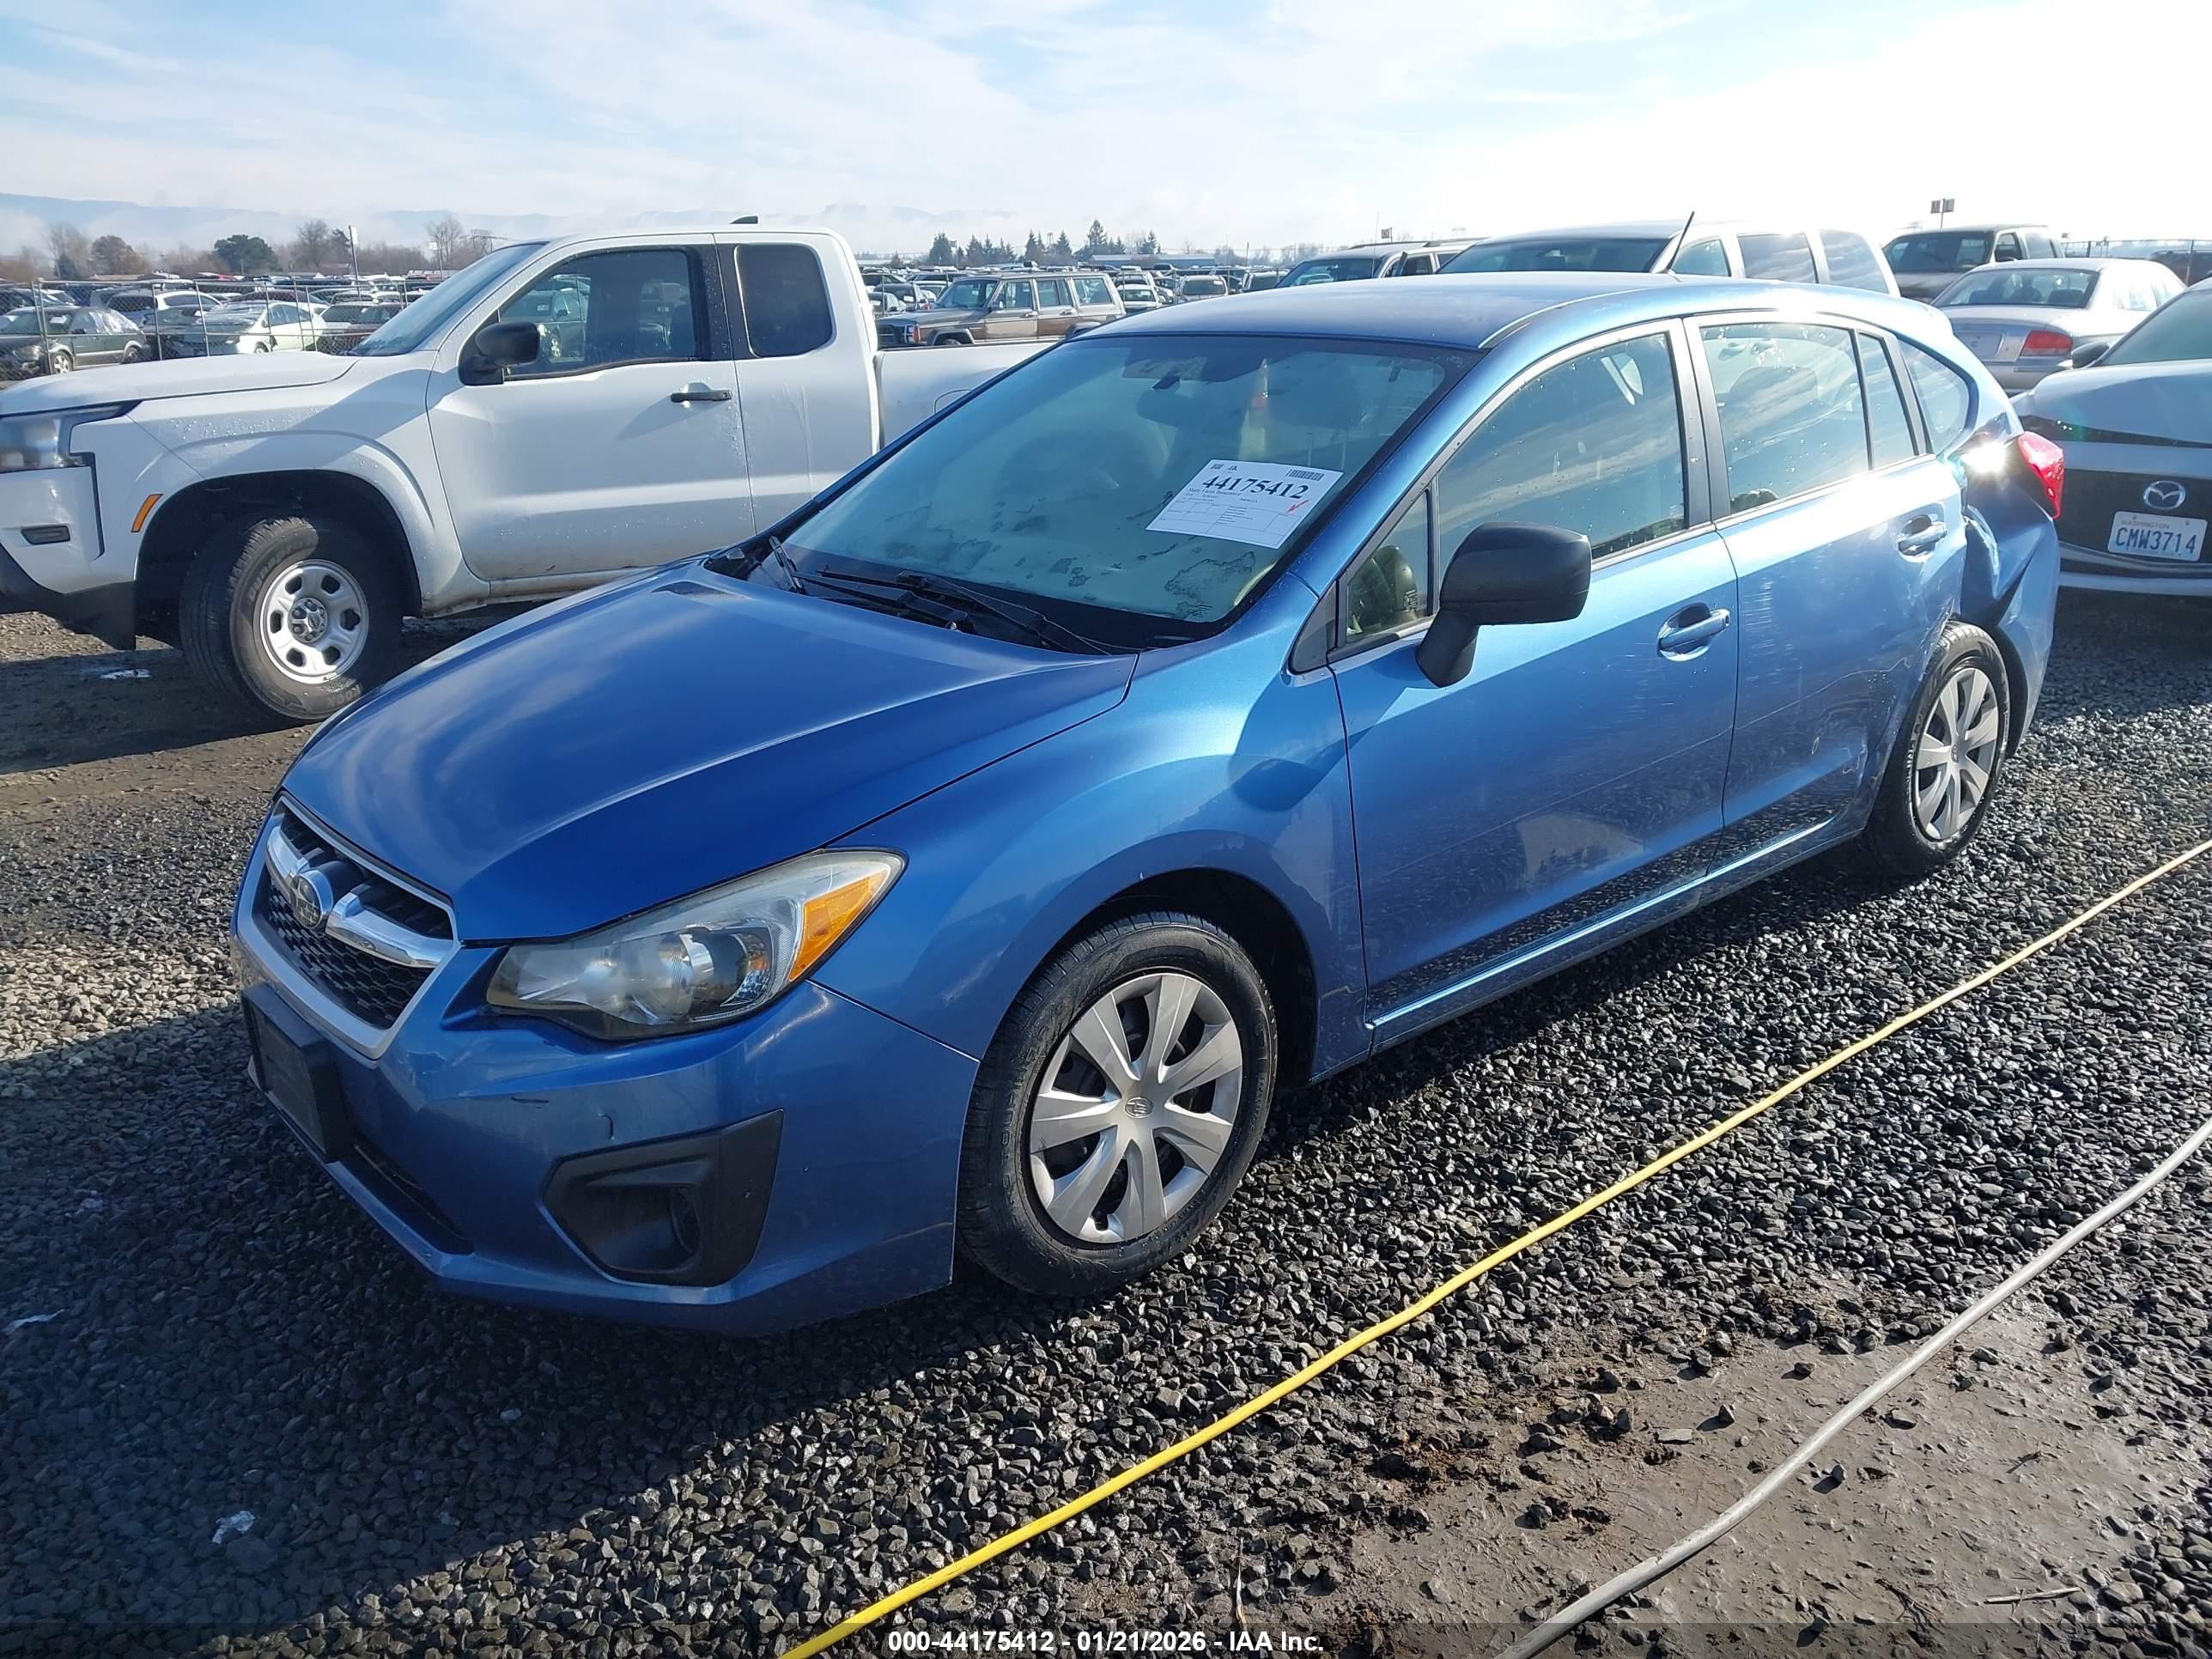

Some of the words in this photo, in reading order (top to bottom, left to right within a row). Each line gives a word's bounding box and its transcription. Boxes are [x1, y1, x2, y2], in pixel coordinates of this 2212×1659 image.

[1202, 475, 1310, 500] 44175412
[2121, 519, 2170, 530] WASHINGTON
[2115, 527, 2197, 555] CMW3714
